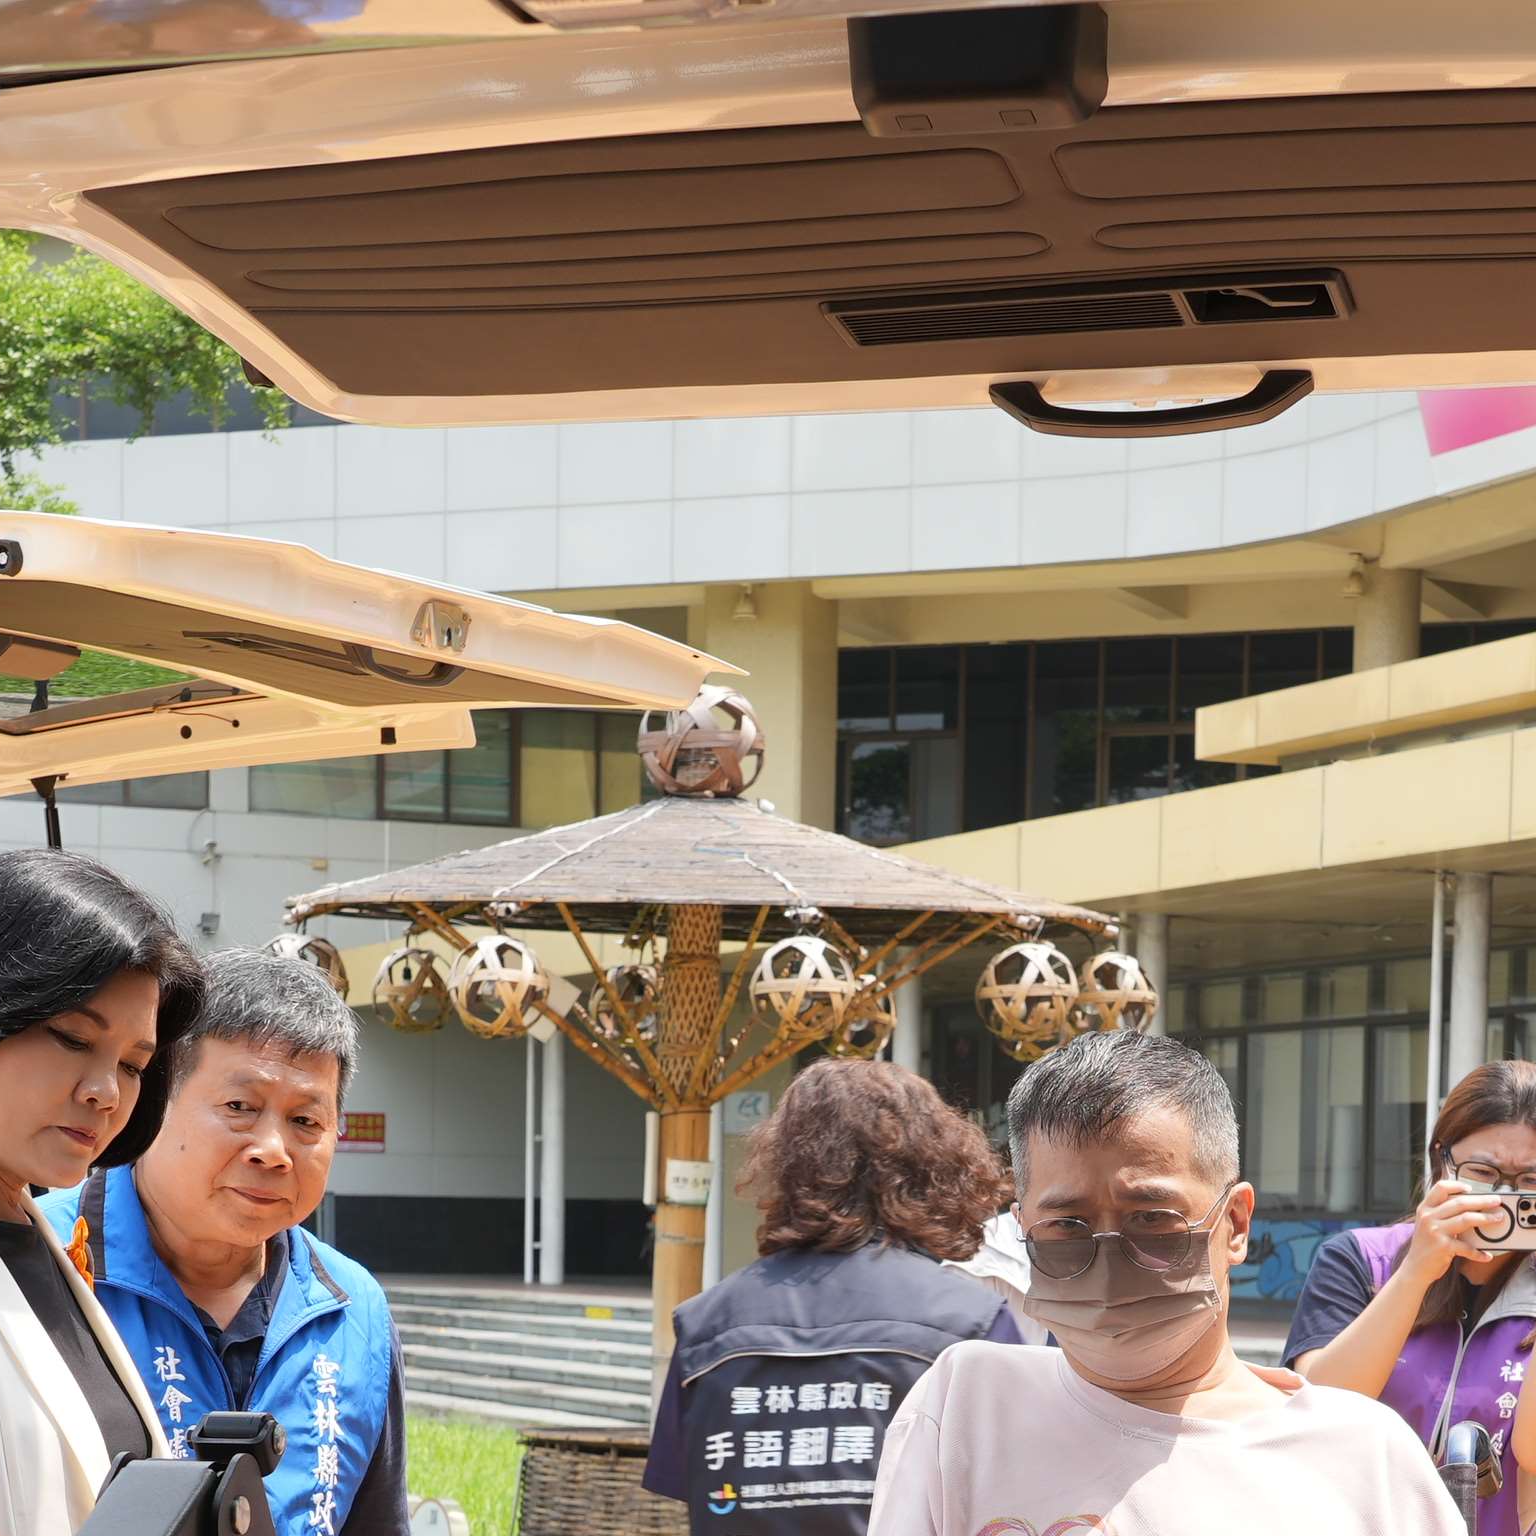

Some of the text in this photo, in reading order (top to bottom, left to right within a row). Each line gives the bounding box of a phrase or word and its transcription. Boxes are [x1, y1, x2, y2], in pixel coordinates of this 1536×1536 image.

[730, 1381, 893, 1414] 雲林縣政府
[704, 1426, 875, 1471] 手語翻譯
